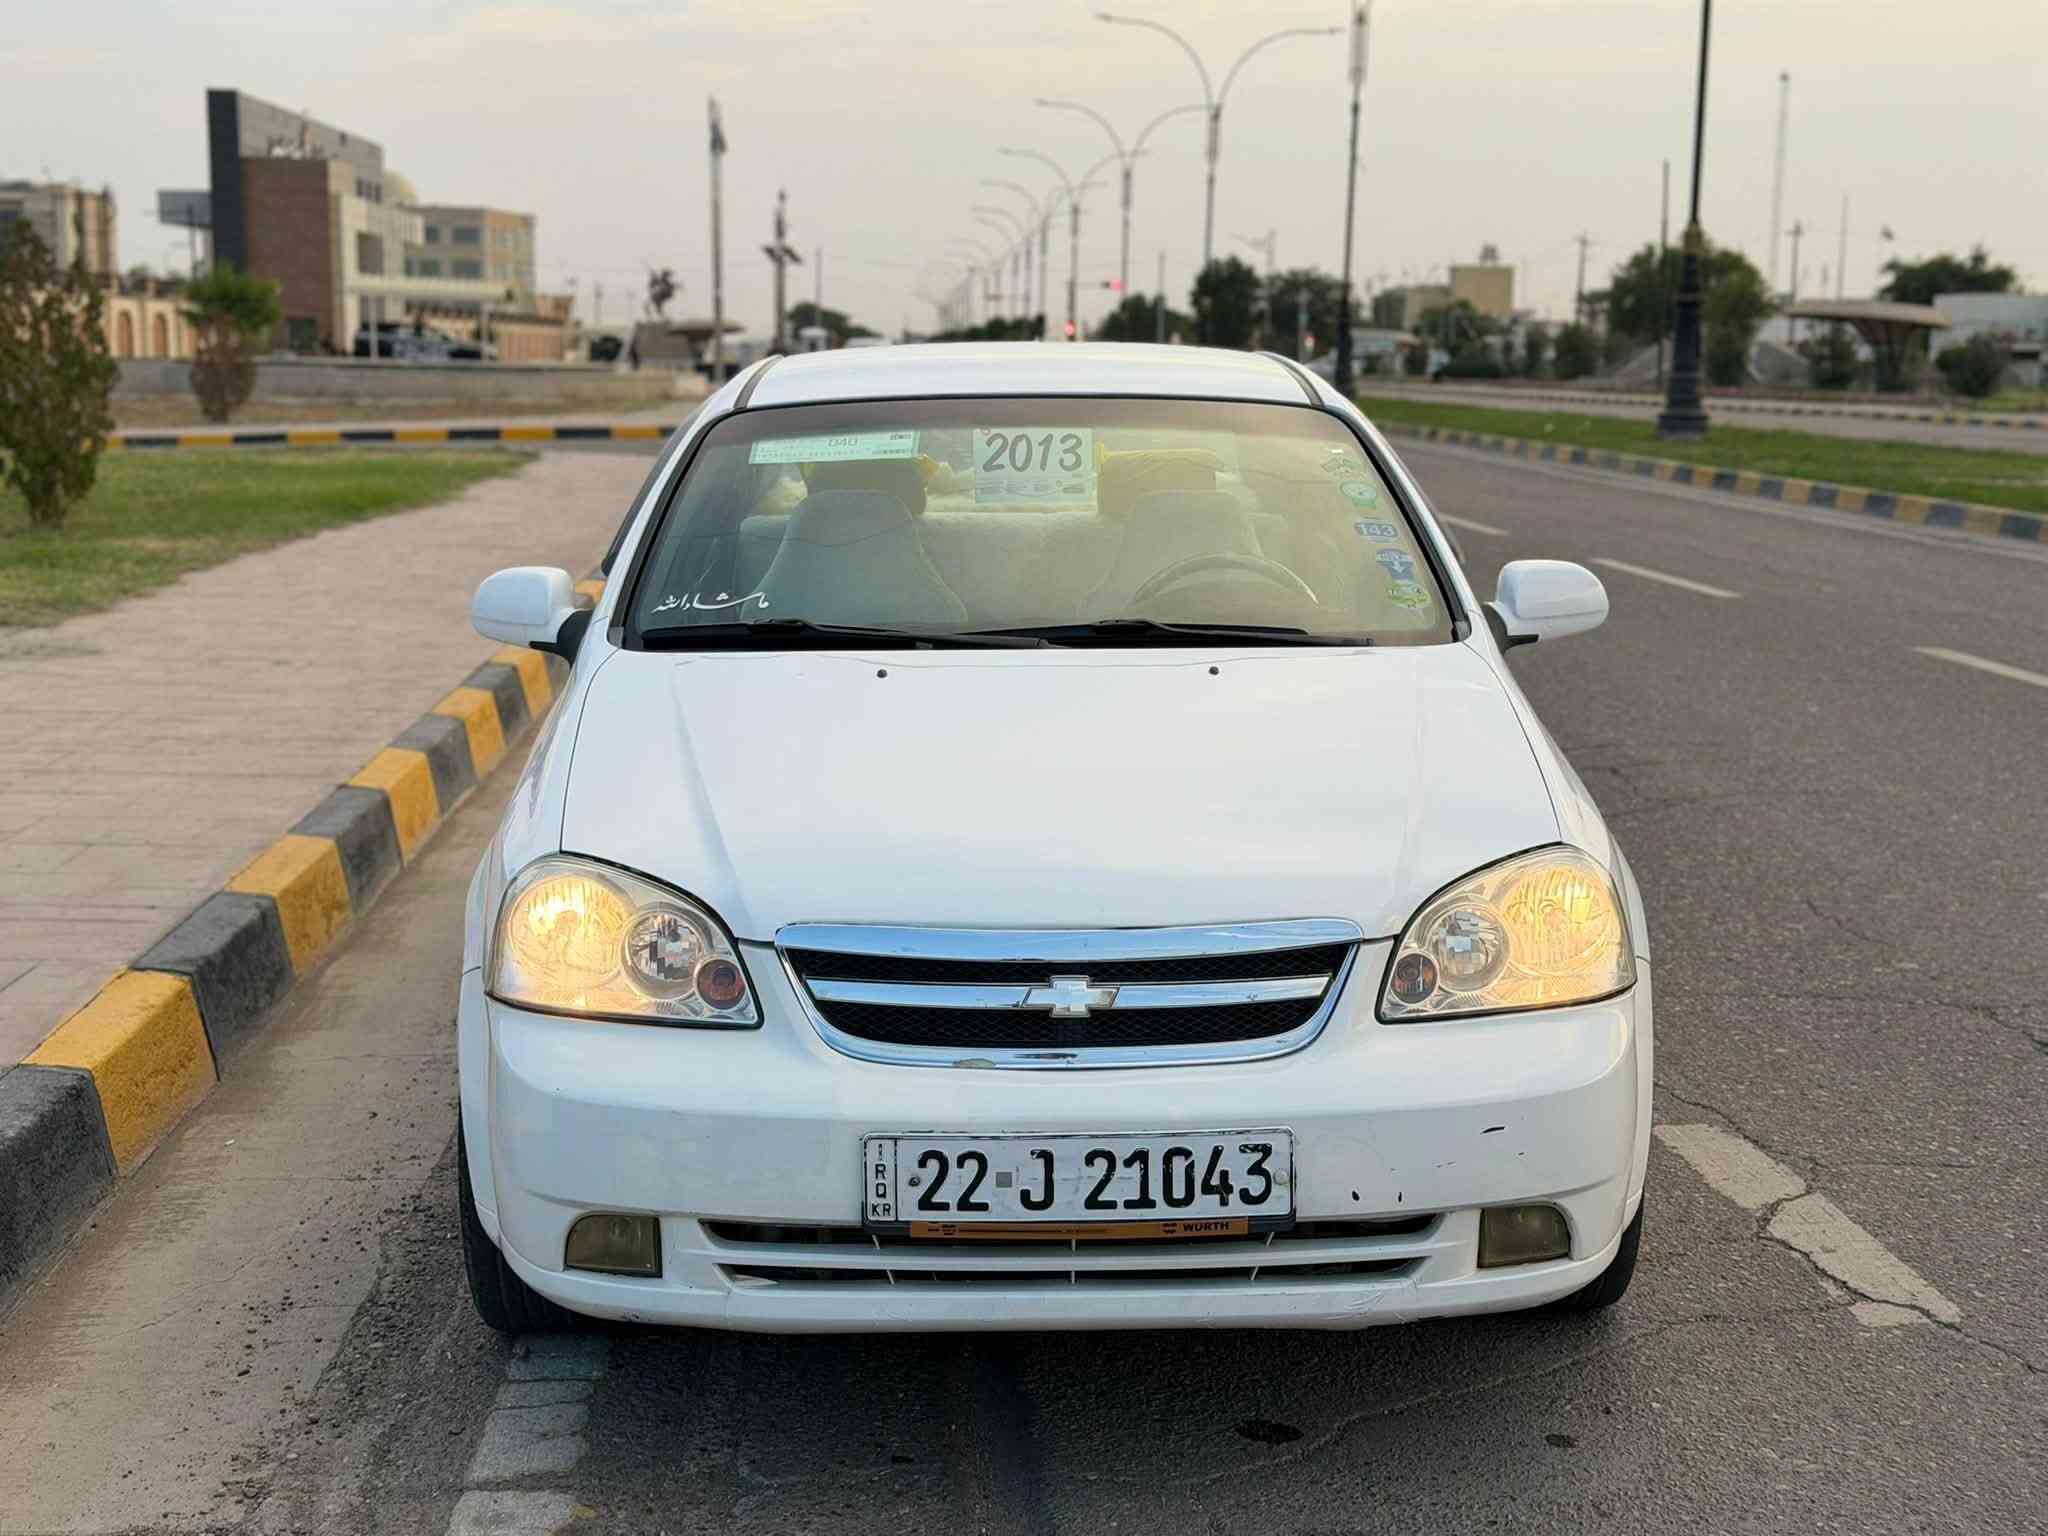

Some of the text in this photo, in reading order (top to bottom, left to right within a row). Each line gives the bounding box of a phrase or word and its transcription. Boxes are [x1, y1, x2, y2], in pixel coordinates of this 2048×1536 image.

[983, 433, 1082, 472] 2013
[917, 1143, 1273, 1212] 22 J 21043
[871, 1202, 892, 1217] KR
